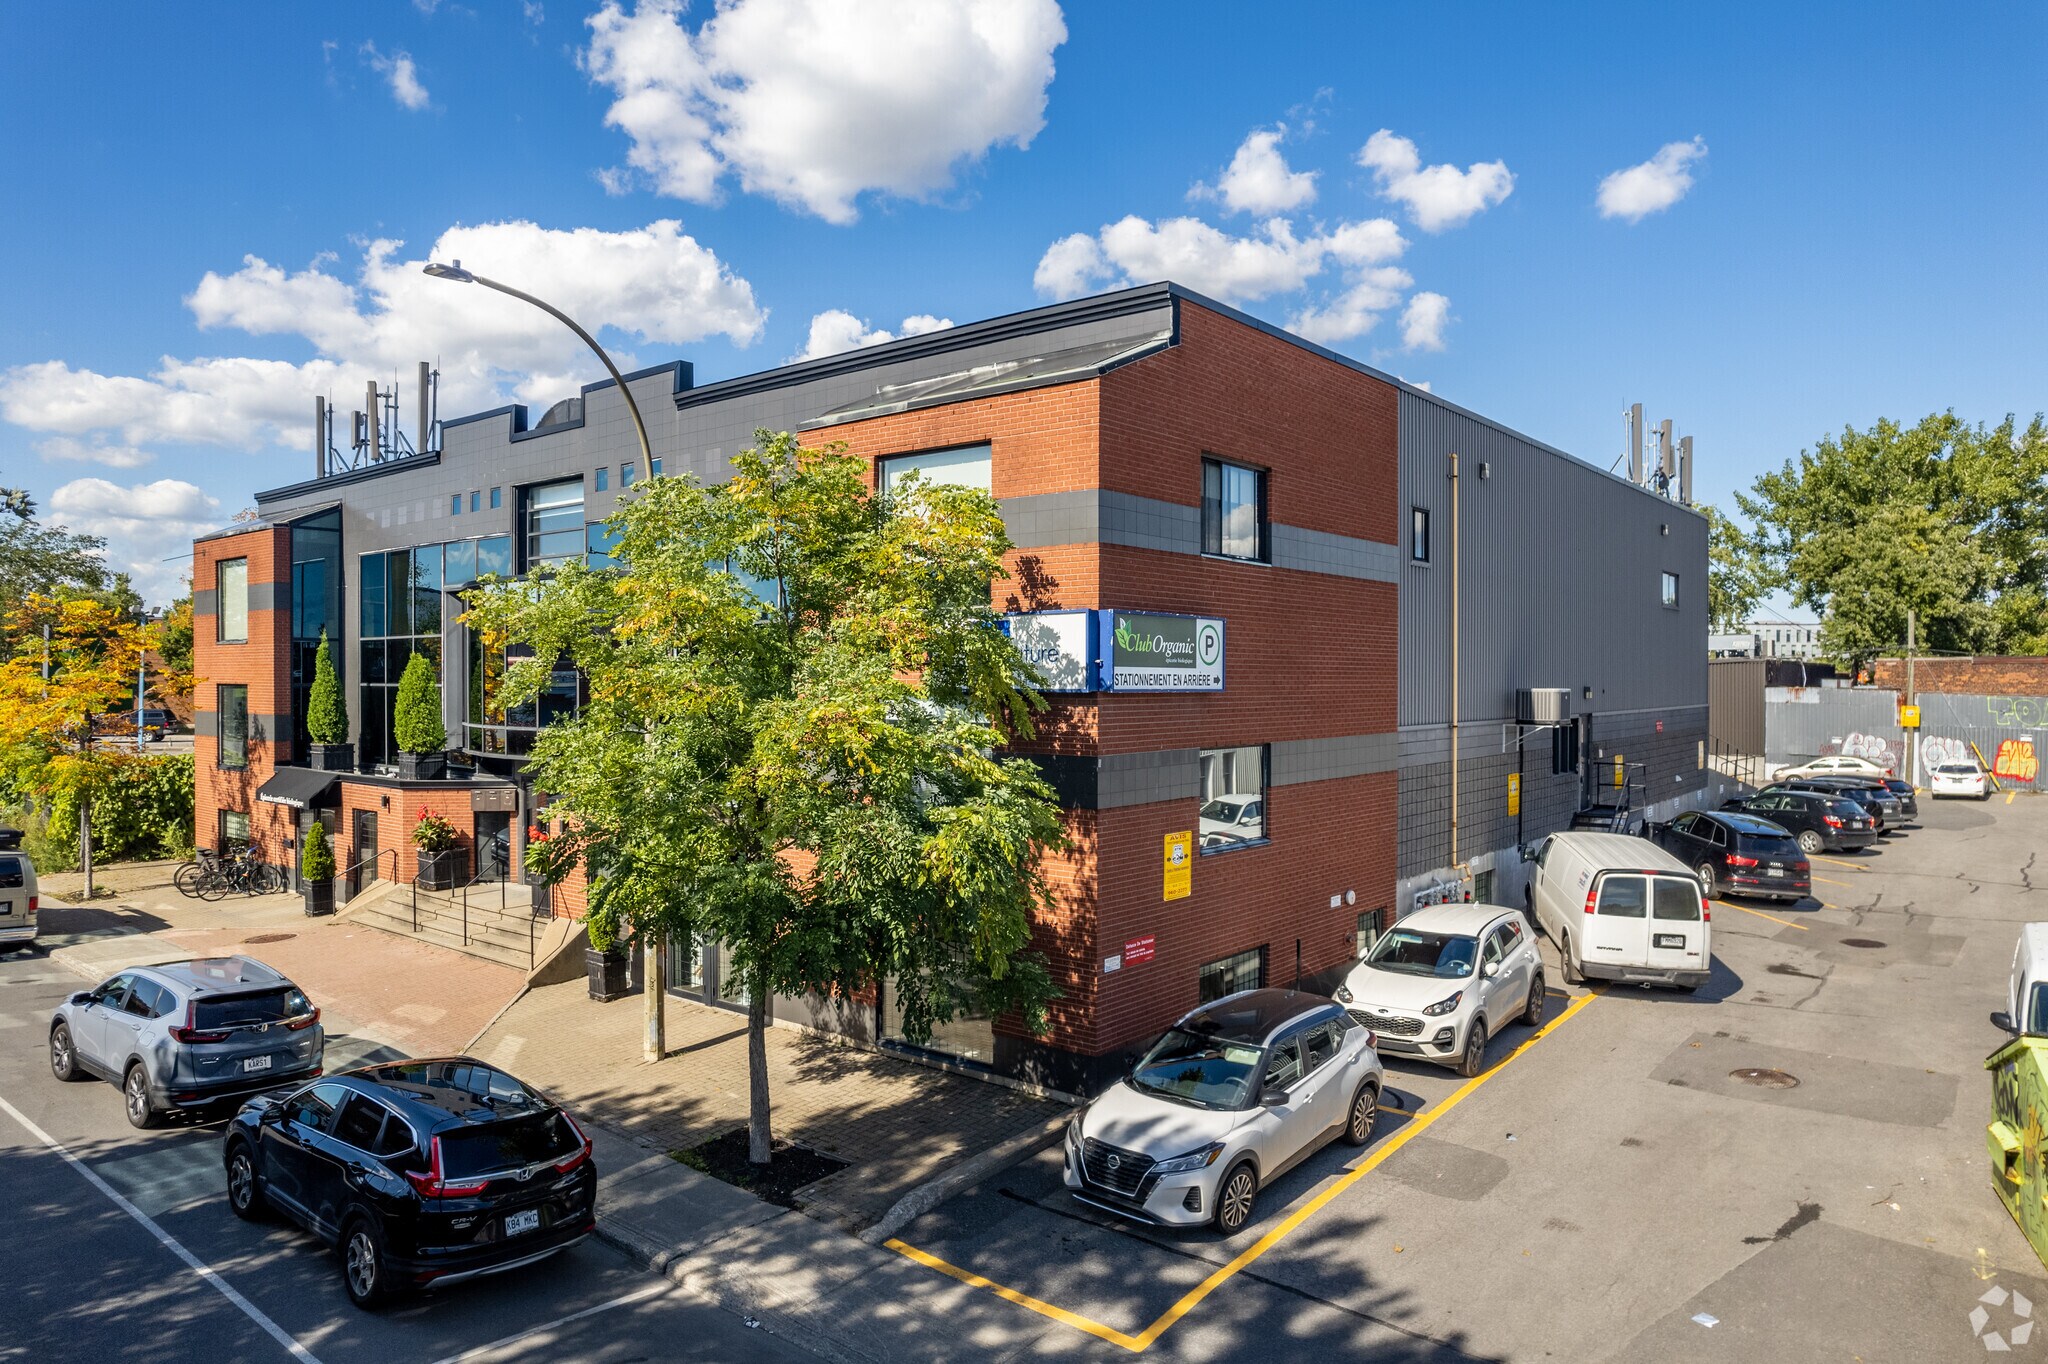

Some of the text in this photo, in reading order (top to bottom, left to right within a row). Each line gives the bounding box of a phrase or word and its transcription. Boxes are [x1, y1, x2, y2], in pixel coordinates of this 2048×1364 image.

[1205, 635, 1214, 656] P
[1114, 673, 1172, 686] STATIONNEMENT
[1173, 674, 1183, 686] EN
